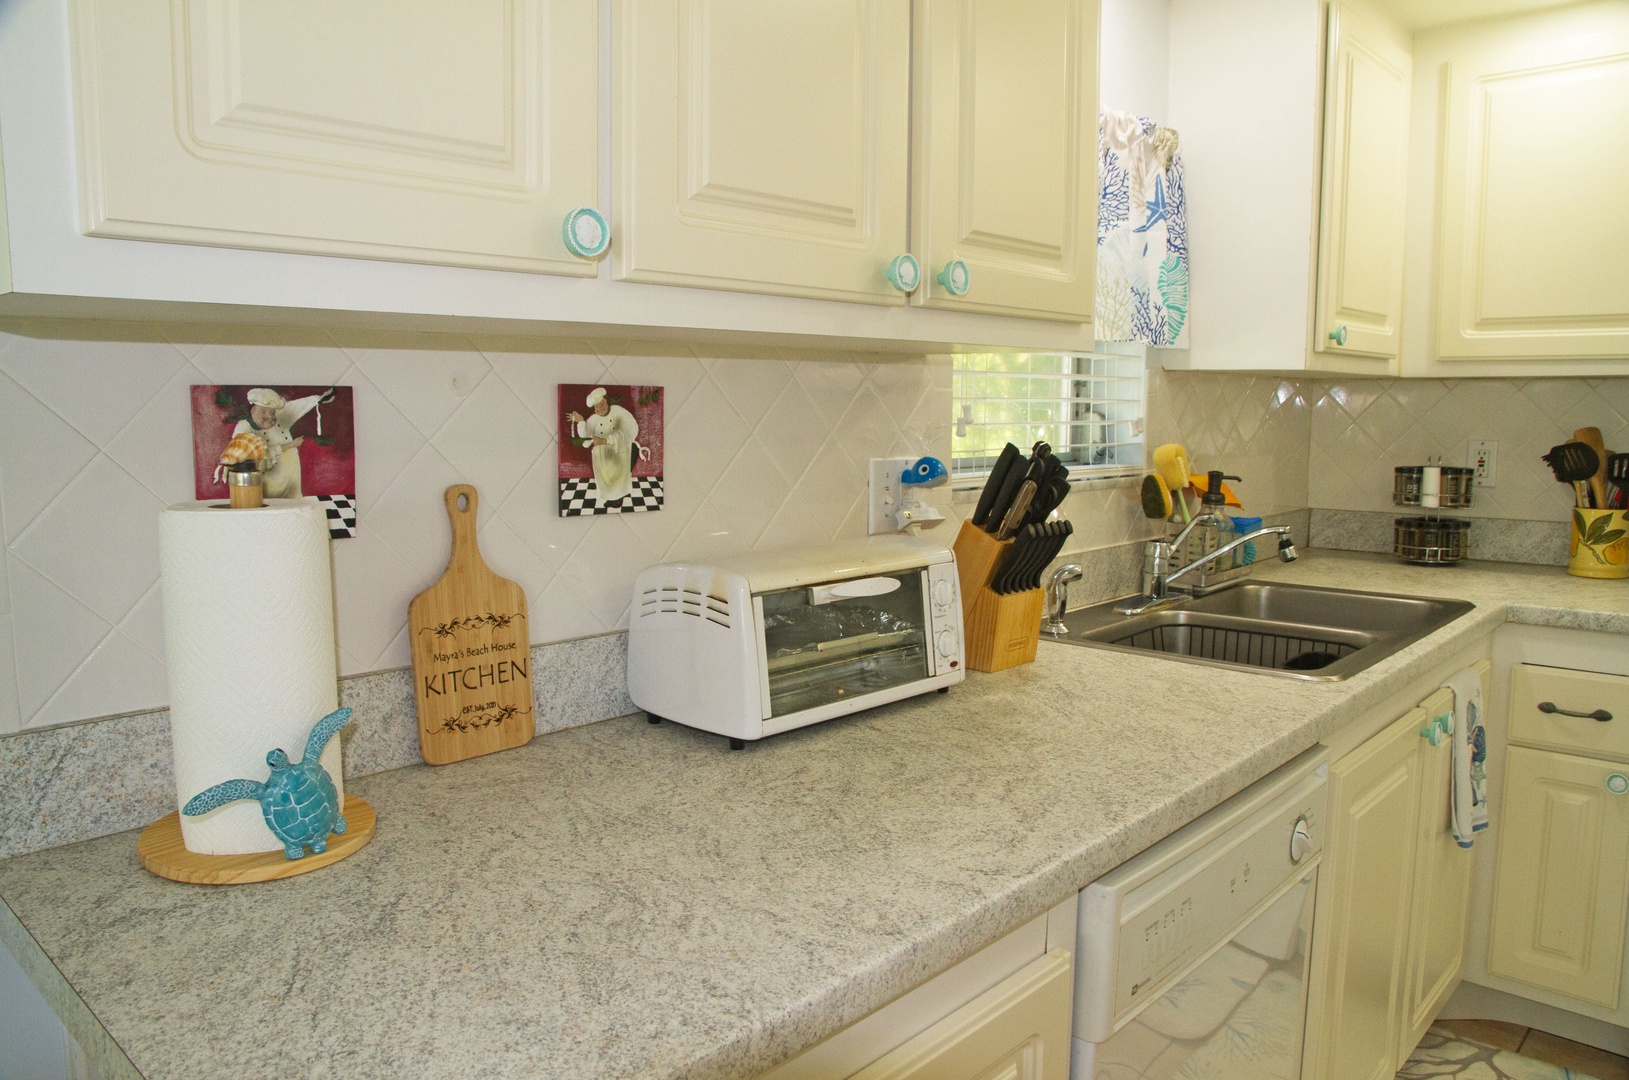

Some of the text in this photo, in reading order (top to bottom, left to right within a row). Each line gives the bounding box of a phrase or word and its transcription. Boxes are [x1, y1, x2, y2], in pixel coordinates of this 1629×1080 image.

[433, 642, 516, 663] Mayra's Beach House
[424, 658, 528, 698] KITCHEN
